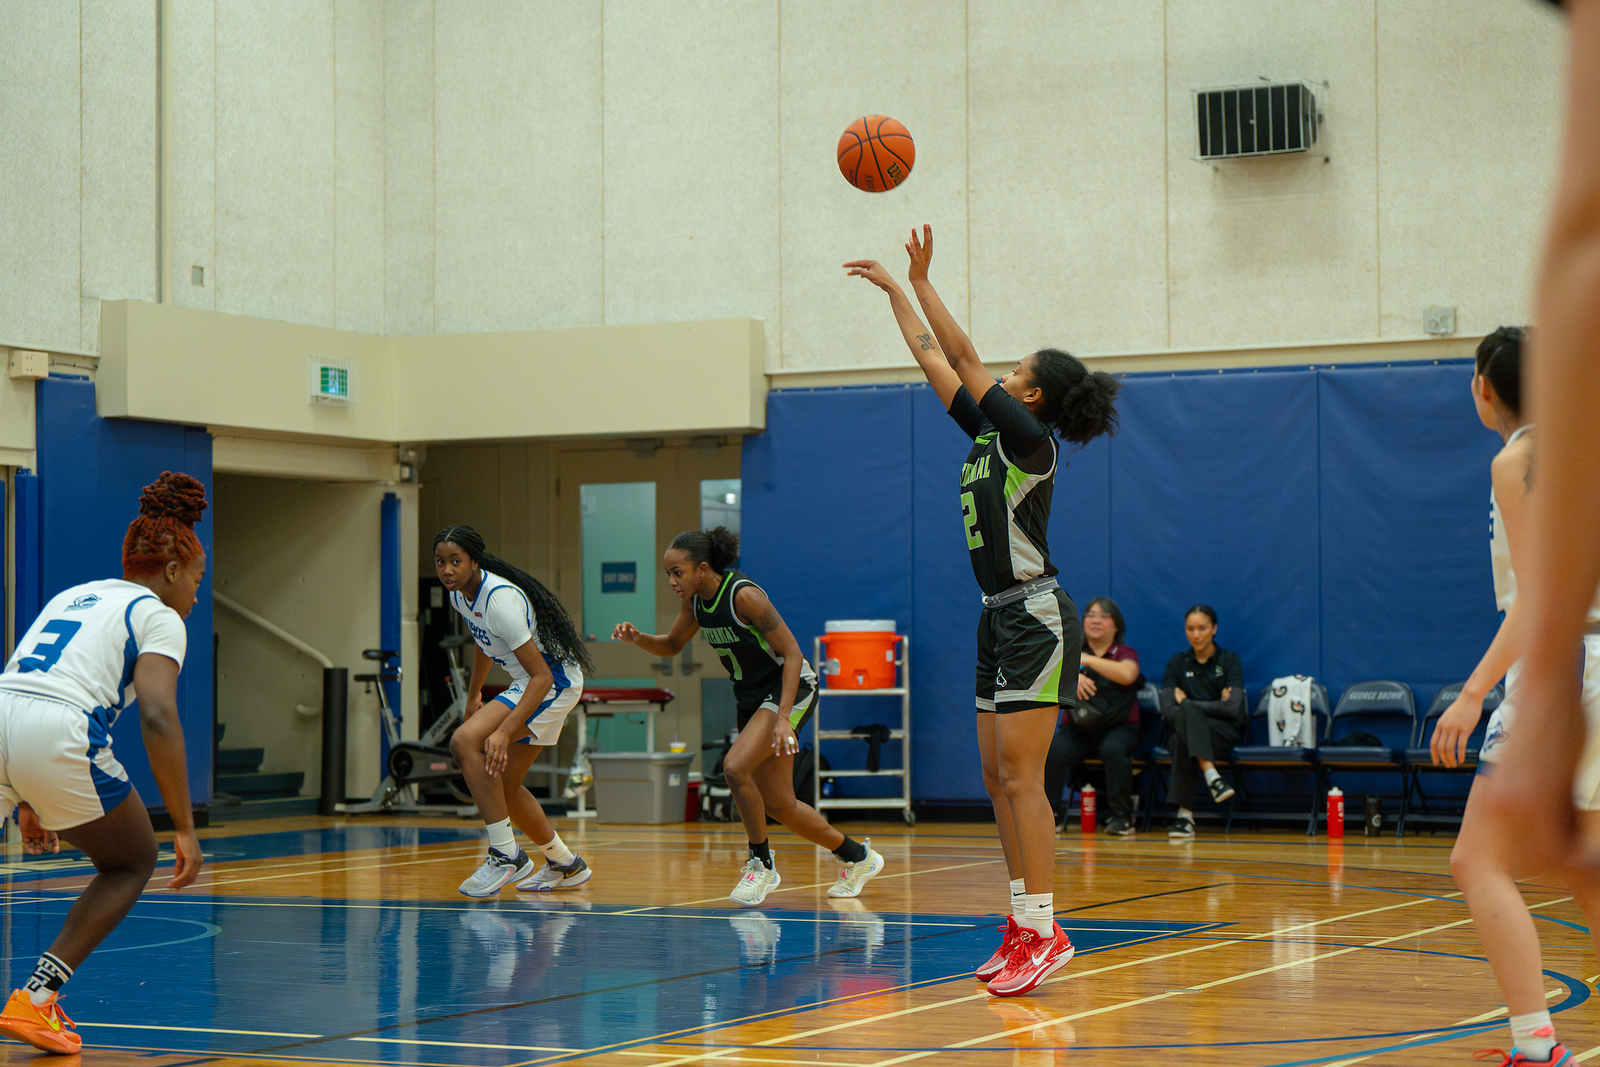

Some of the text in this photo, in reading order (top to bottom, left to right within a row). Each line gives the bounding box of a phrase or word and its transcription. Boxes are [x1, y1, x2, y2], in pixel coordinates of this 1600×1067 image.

[960, 491, 984, 551] 2
[17, 619, 82, 673] 3
[714, 647, 743, 681] 7
